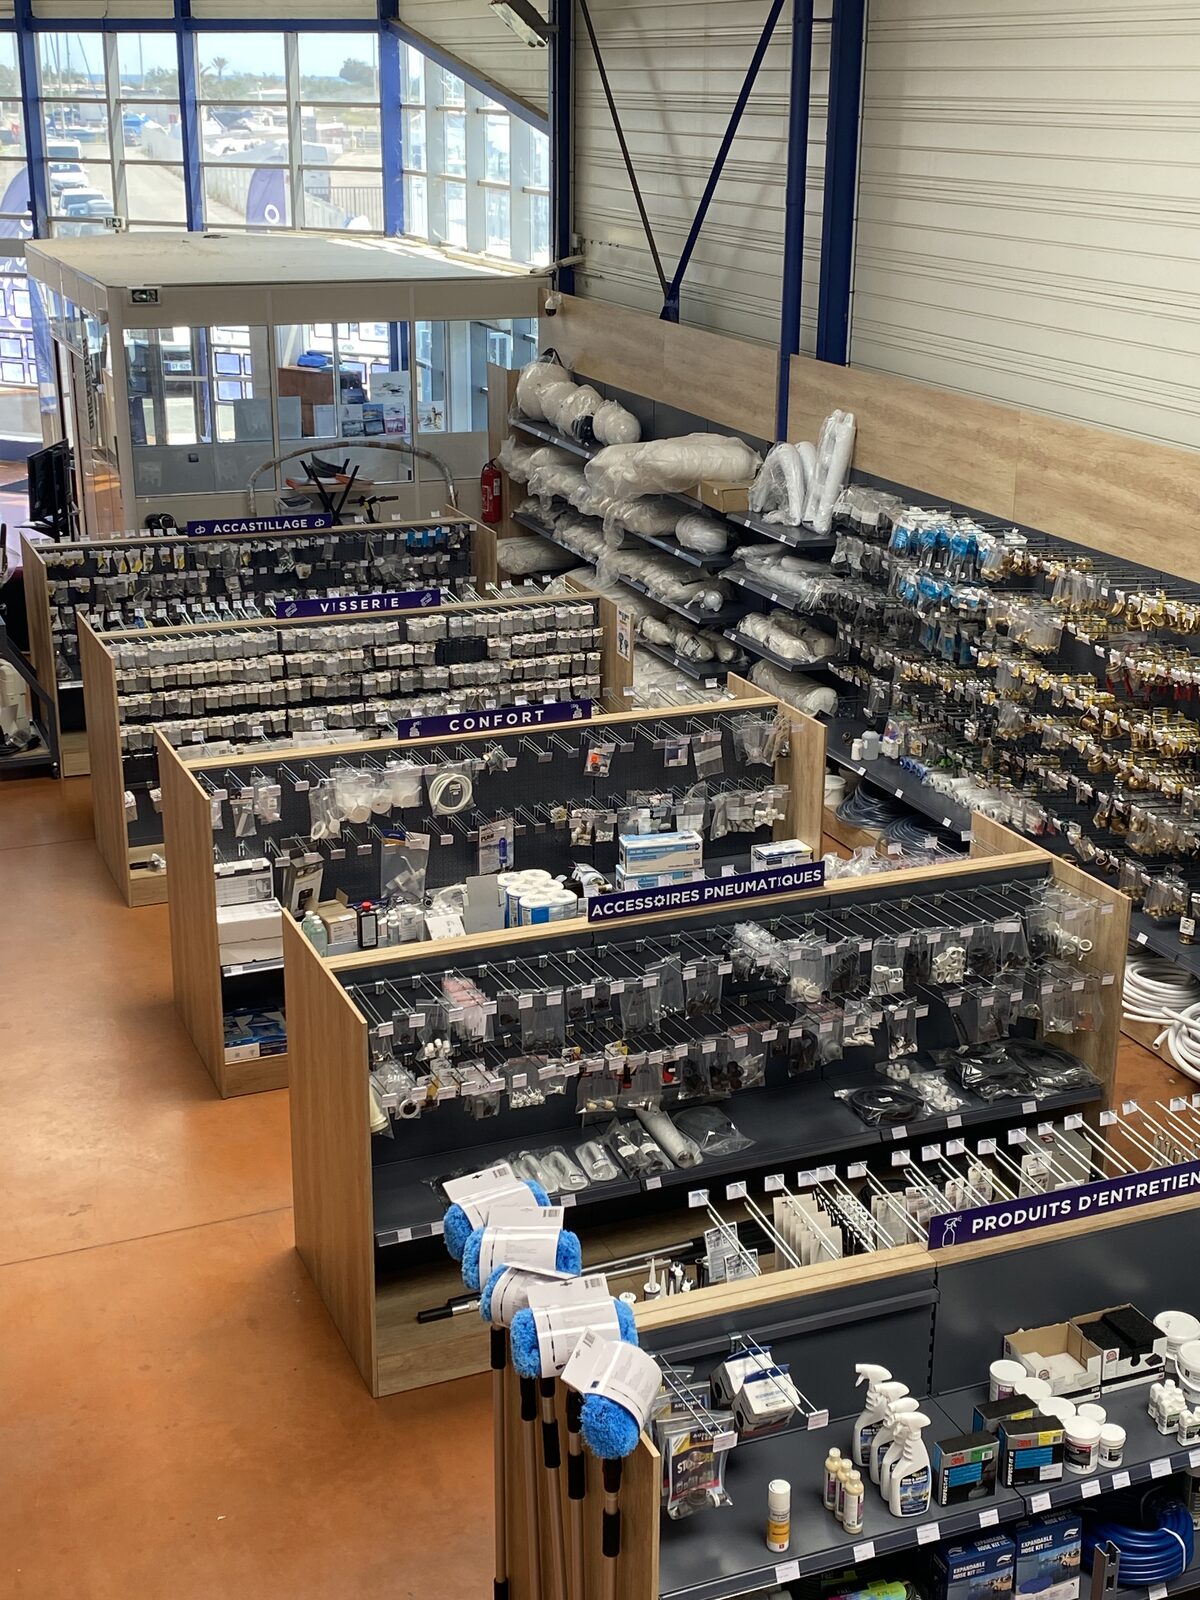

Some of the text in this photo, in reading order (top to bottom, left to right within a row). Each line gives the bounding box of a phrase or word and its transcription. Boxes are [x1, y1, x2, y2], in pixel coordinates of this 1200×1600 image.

[213, 519, 308, 534] ACCASTILLAGE
[320, 597, 399, 613] VISSERIE
[448, 709, 545, 731] CONFORT
[591, 869, 822, 918] ACCESSOIRES PNEUMATIQUES
[971, 1199, 1072, 1234] PRODUITS
